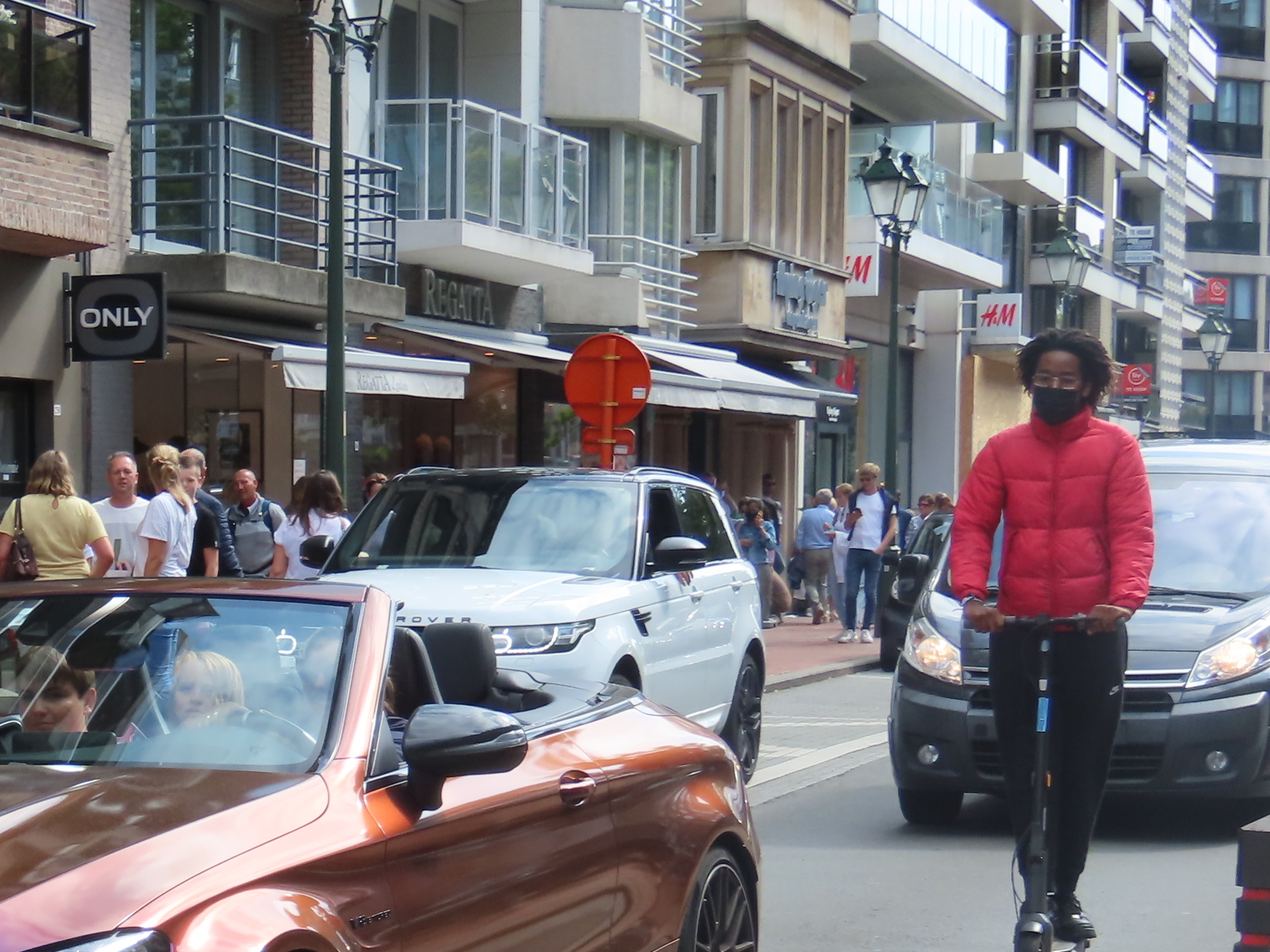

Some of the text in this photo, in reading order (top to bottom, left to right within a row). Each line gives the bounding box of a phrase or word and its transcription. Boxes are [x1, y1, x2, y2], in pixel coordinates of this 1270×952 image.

[423, 267, 495, 325] REGATTA
[79, 306, 154, 329] ONLY
[980, 303, 1017, 328] H&M
